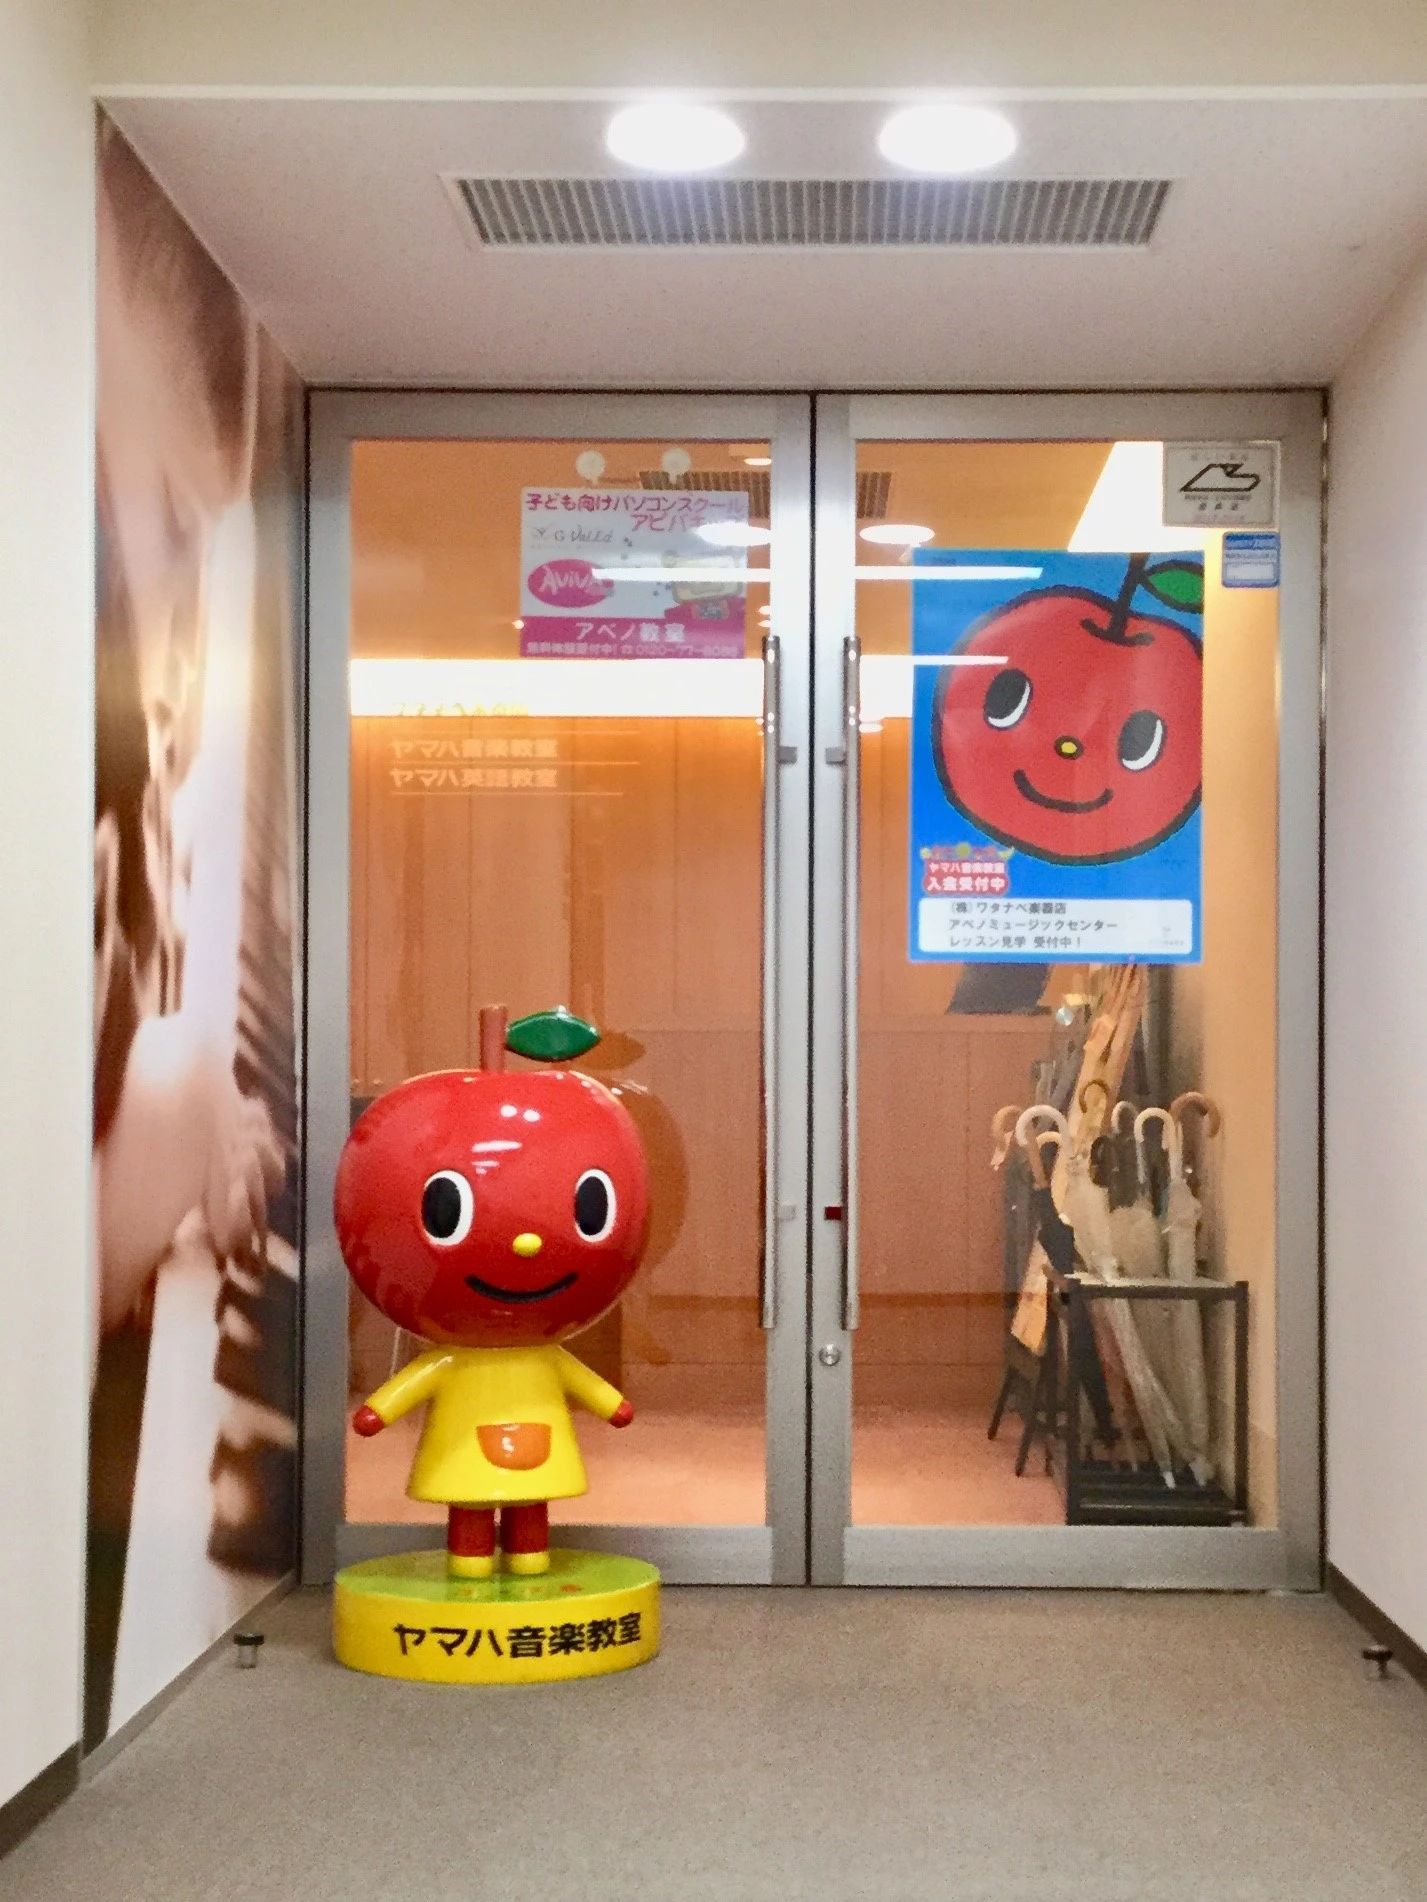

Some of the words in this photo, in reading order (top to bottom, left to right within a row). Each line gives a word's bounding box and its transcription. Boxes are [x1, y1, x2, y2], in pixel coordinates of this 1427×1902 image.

[526, 492, 744, 512] 子ども向けパソコンスクール
[575, 622, 685, 642] アベノ教室
[926, 876, 1006, 892] 入会受付中
[393, 1611, 642, 1658] ヤマハ音楽教室
